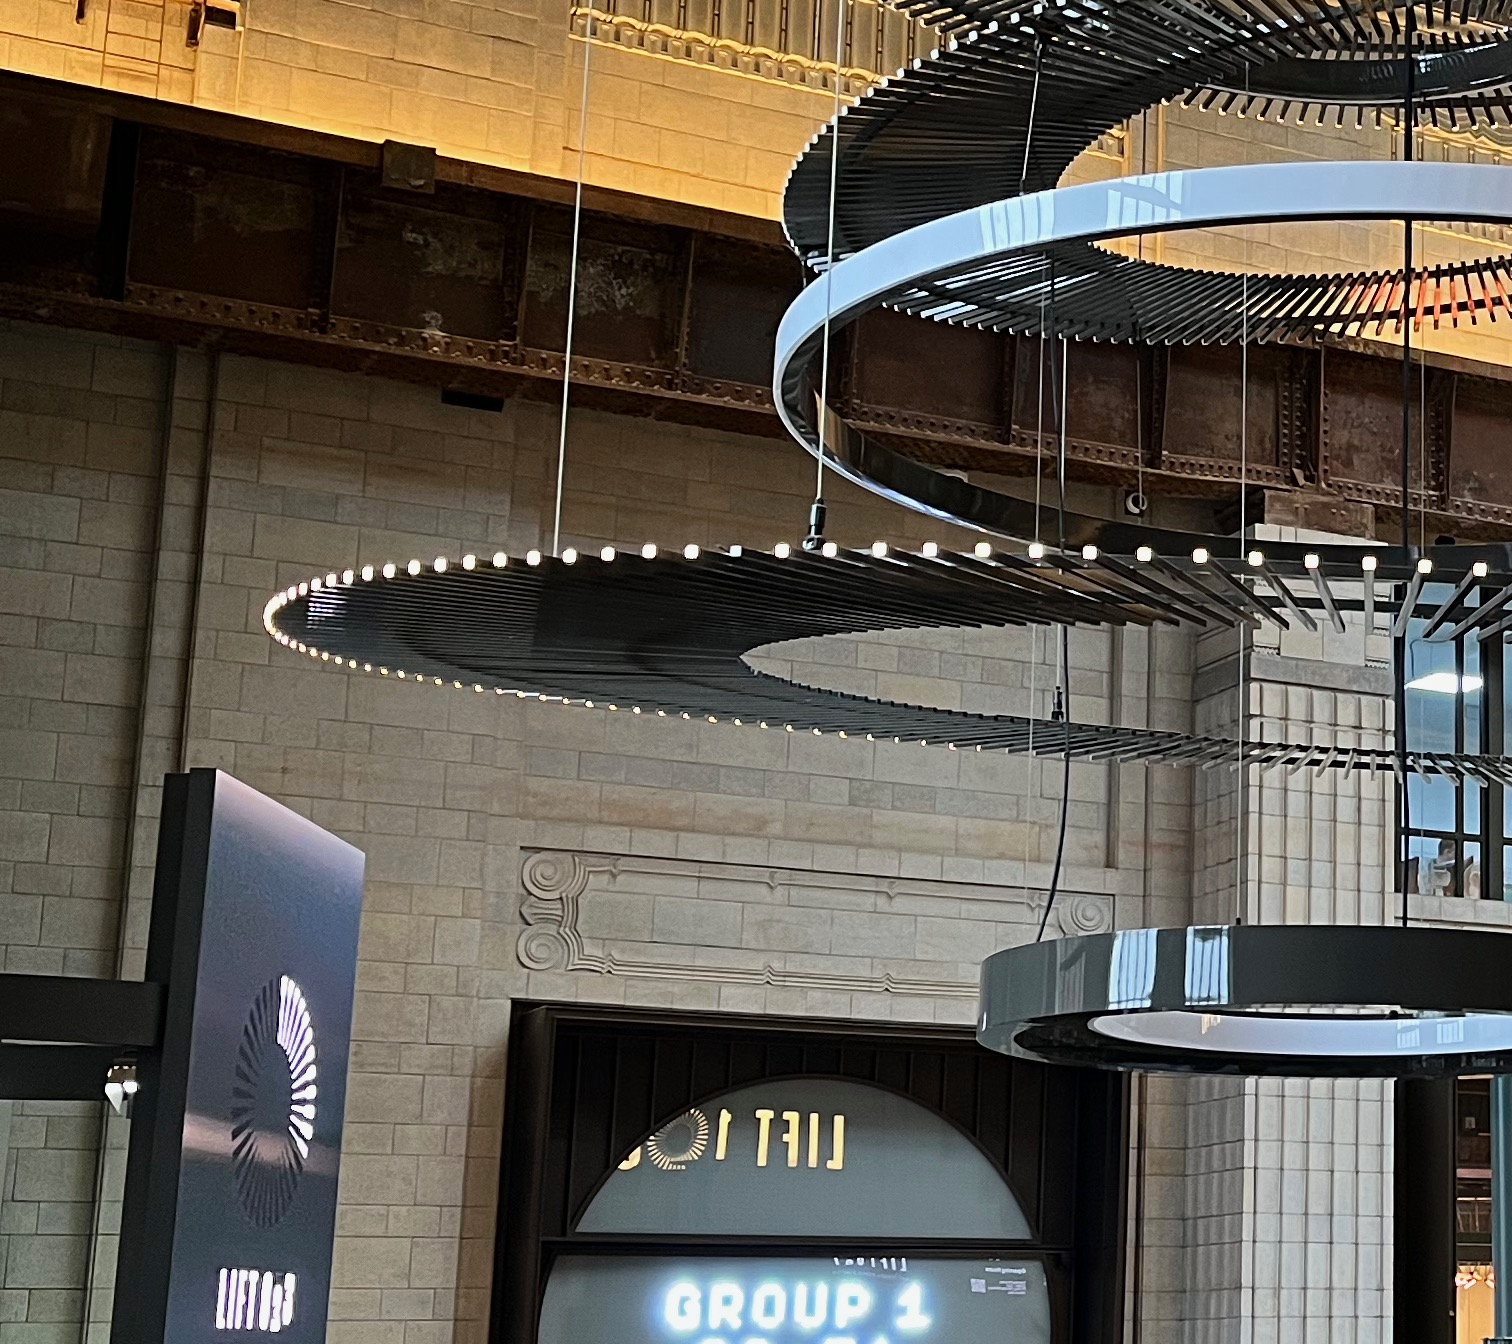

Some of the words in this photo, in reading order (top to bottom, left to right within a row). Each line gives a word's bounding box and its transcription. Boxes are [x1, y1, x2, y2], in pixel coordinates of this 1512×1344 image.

[215, 1267, 260, 1331] LIFT
[664, 1281, 872, 1331] GROUP
[894, 1280, 932, 1331] 1
